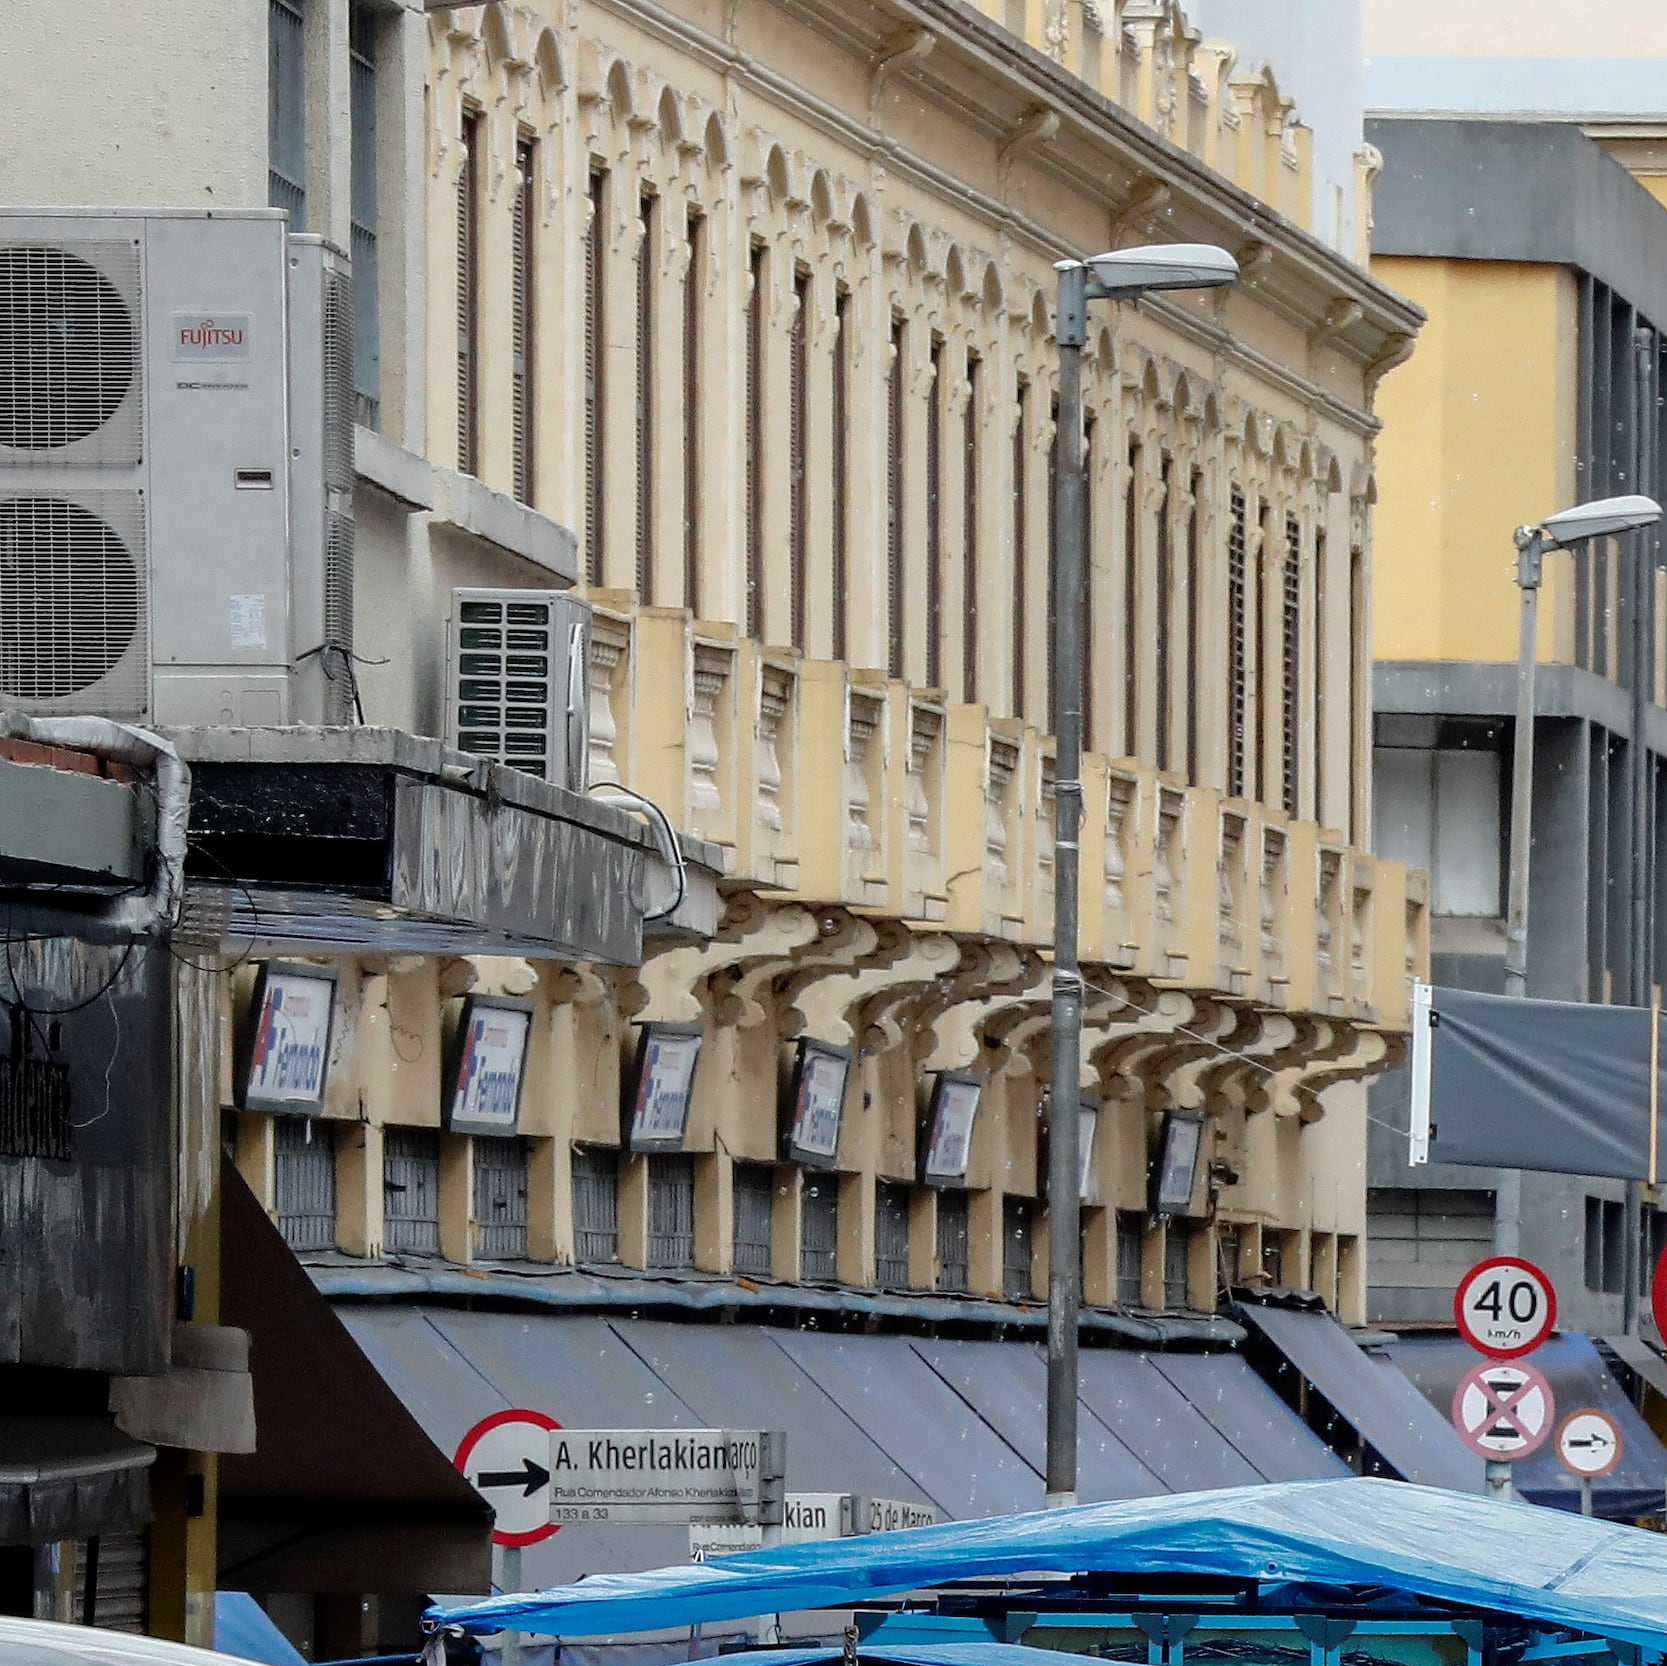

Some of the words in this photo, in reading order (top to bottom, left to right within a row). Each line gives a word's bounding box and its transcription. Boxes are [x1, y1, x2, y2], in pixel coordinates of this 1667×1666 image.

[181, 320, 242, 349] FUJITSU
[1473, 1281, 1537, 1323] 40
[1488, 1329, 1521, 1339] km/h
[589, 1438, 727, 1470] Kherlakian
[554, 1487, 576, 1498] Rua
[577, 1487, 646, 1498] Comendador
[556, 1508, 578, 1520] 133
[593, 1508, 609, 1520] 33
